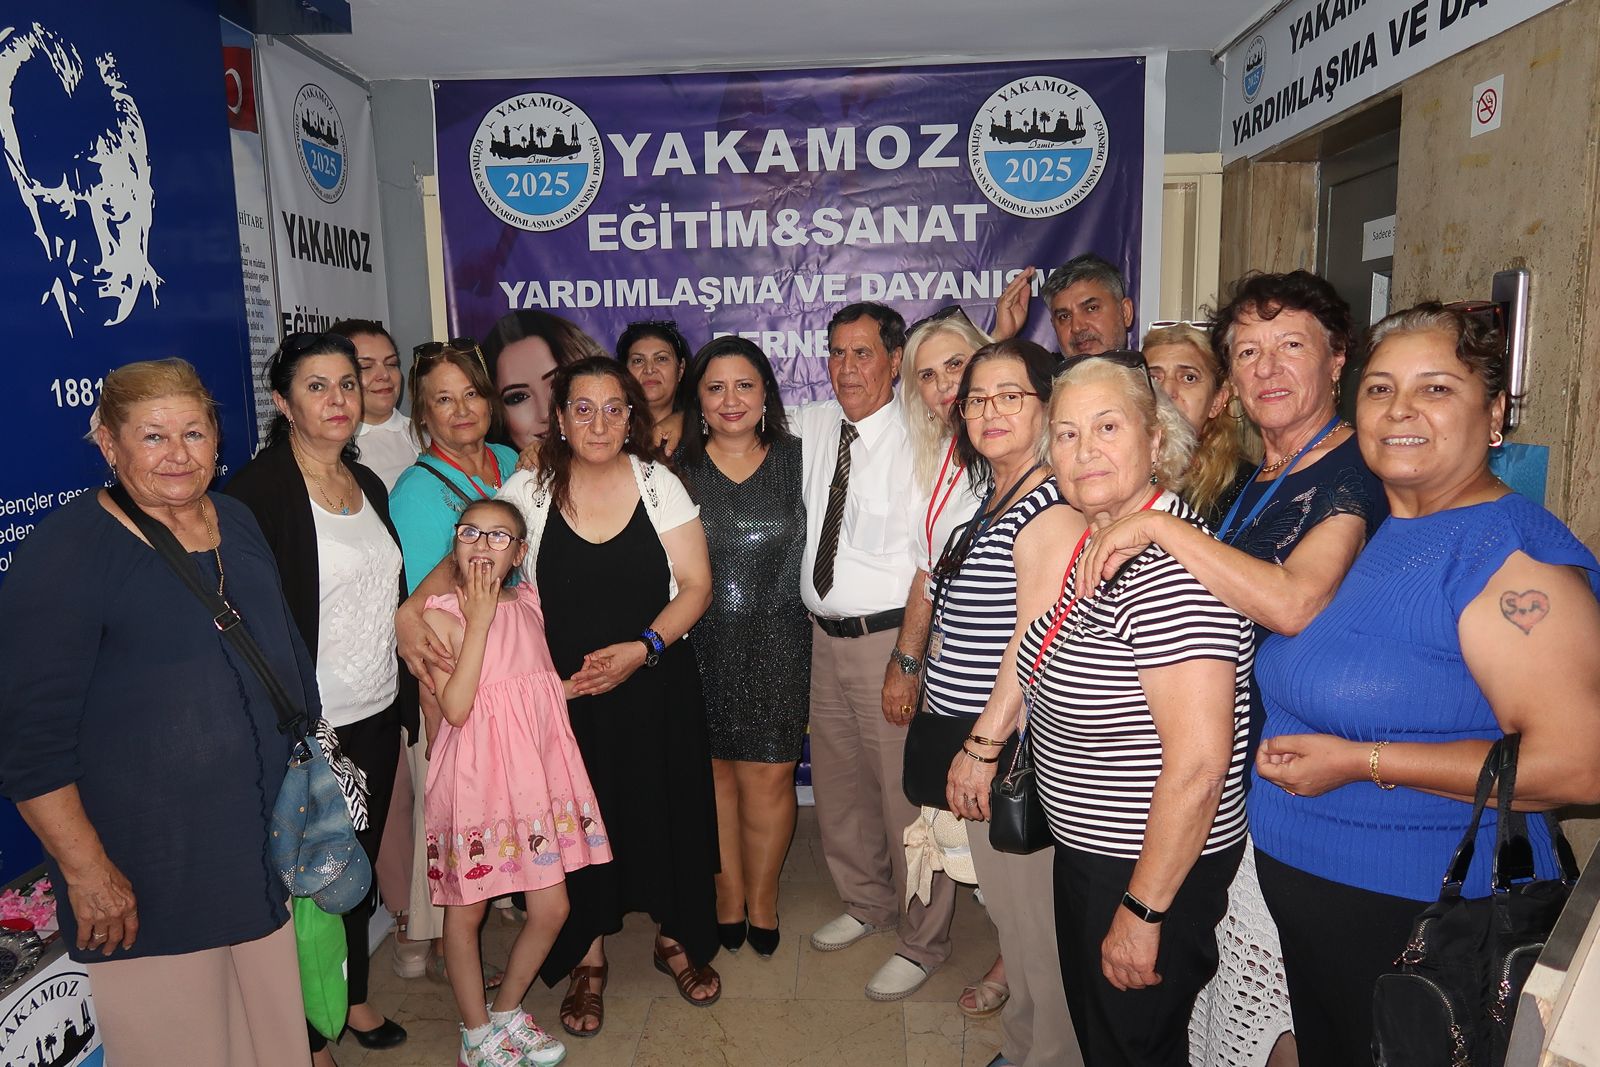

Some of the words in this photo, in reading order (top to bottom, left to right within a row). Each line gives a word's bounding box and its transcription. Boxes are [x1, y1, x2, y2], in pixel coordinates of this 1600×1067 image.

[998, 80, 1079, 102] YAKAMOZ
[1232, 32, 1378, 147] YARDIMLAŞMA
[1389, 2, 1429, 57] VE
[496, 97, 573, 118] YAKAMOZ
[606, 124, 962, 178] YAKAMOZ
[972, 123, 983, 158] EĞİTİM
[1093, 120, 1105, 161] DERNEĞİ
[310, 149, 337, 177] 2025
[975, 167, 993, 196] SANAT
[1005, 156, 1072, 183] 2025
[473, 139, 483, 171] EĞİTİM
[479, 180, 497, 207] SANAT
[495, 203, 556, 230] YARDIMLAŞMA
[564, 180, 598, 220] DAYANIŞMA
[588, 136, 601, 176] DERNEĞİ
[505, 171, 570, 197] 2025
[1064, 165, 1101, 207] DAYANIŞMA
[991, 192, 1054, 216] YARDIMLAŞMA
[281, 211, 373, 274] YAKAMOZ
[588, 202, 989, 251] EĞİTİM&SANAT
[1372, 229, 1392, 241] Sadece
[499, 276, 783, 313] YARDIMLAŞMA
[794, 273, 848, 303] VE
[861, 268, 1056, 302] DAYANIM
[0, 980, 79, 1052] AKAMOZ
